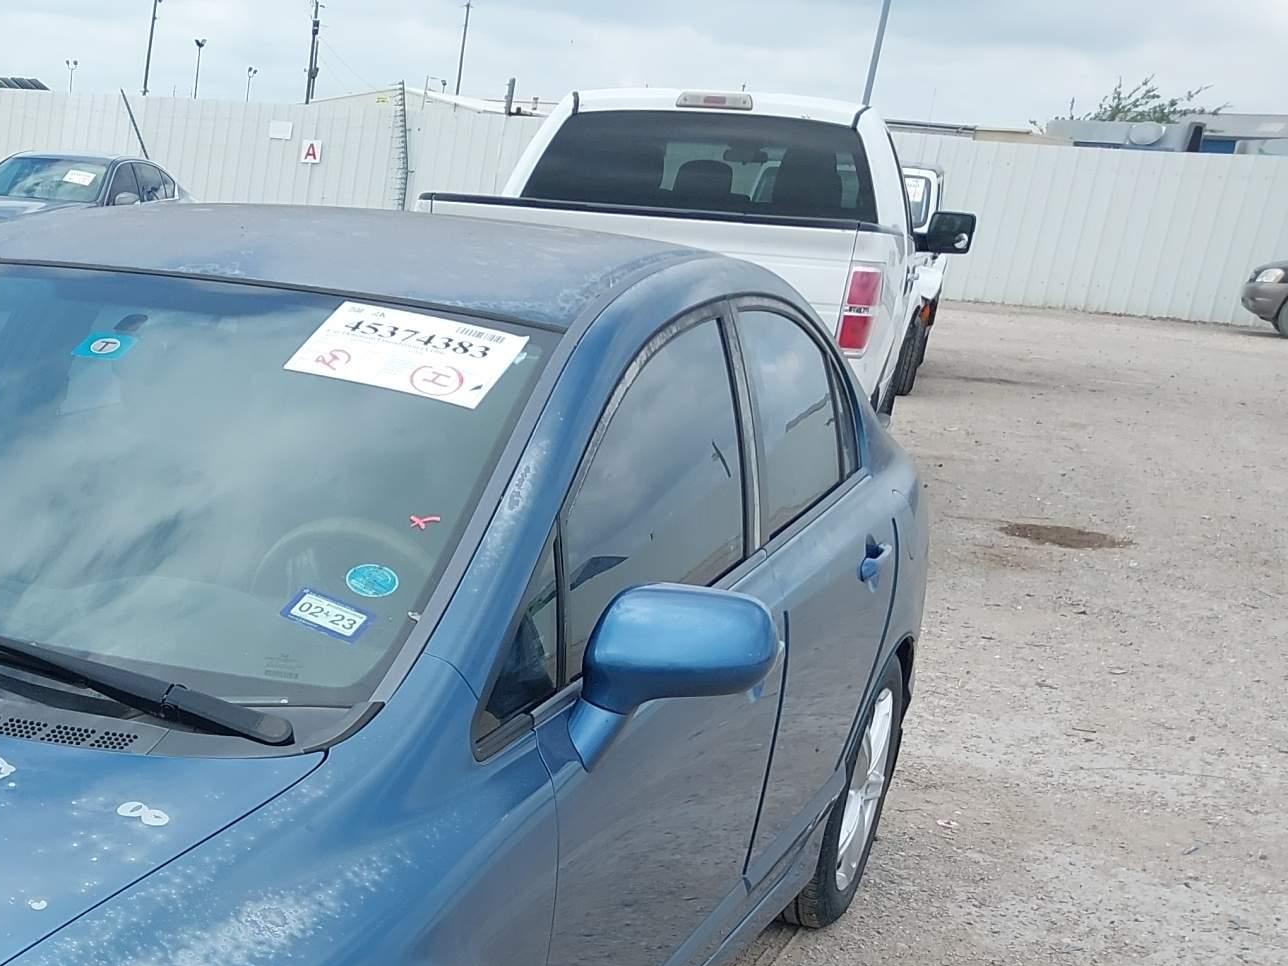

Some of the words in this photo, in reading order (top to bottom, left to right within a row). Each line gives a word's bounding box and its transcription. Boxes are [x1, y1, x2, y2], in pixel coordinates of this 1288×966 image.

[304, 143, 317, 160] A
[344, 320, 491, 359] 45374383
[298, 601, 325, 618] 02
[329, 613, 357, 631] 23
